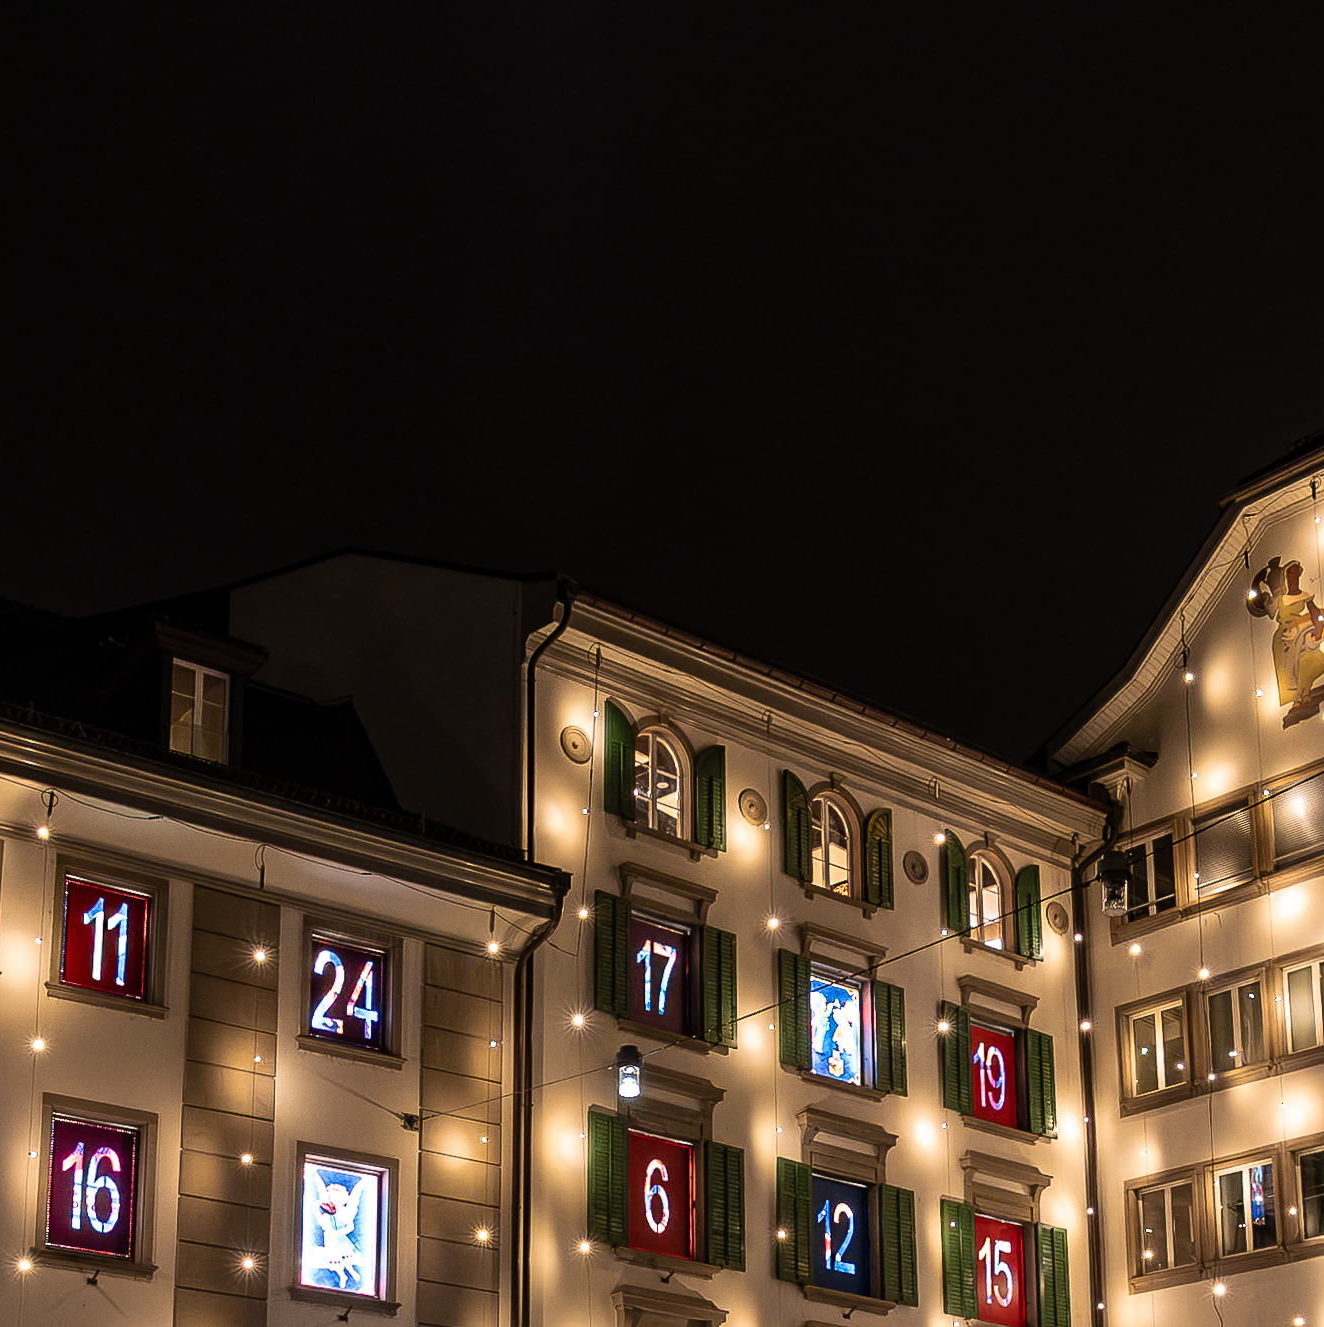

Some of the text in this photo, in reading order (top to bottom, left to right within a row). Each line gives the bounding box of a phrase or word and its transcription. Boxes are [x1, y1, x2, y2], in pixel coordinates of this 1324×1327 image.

[83, 897, 128, 986] 11
[637, 940, 676, 1015] 17
[311, 948, 380, 1039] 24
[974, 1043, 1005, 1110] 19
[62, 1142, 121, 1233] 16
[645, 1159, 669, 1233] 6
[818, 1200, 855, 1274] 12
[979, 1238, 1013, 1307] 15
